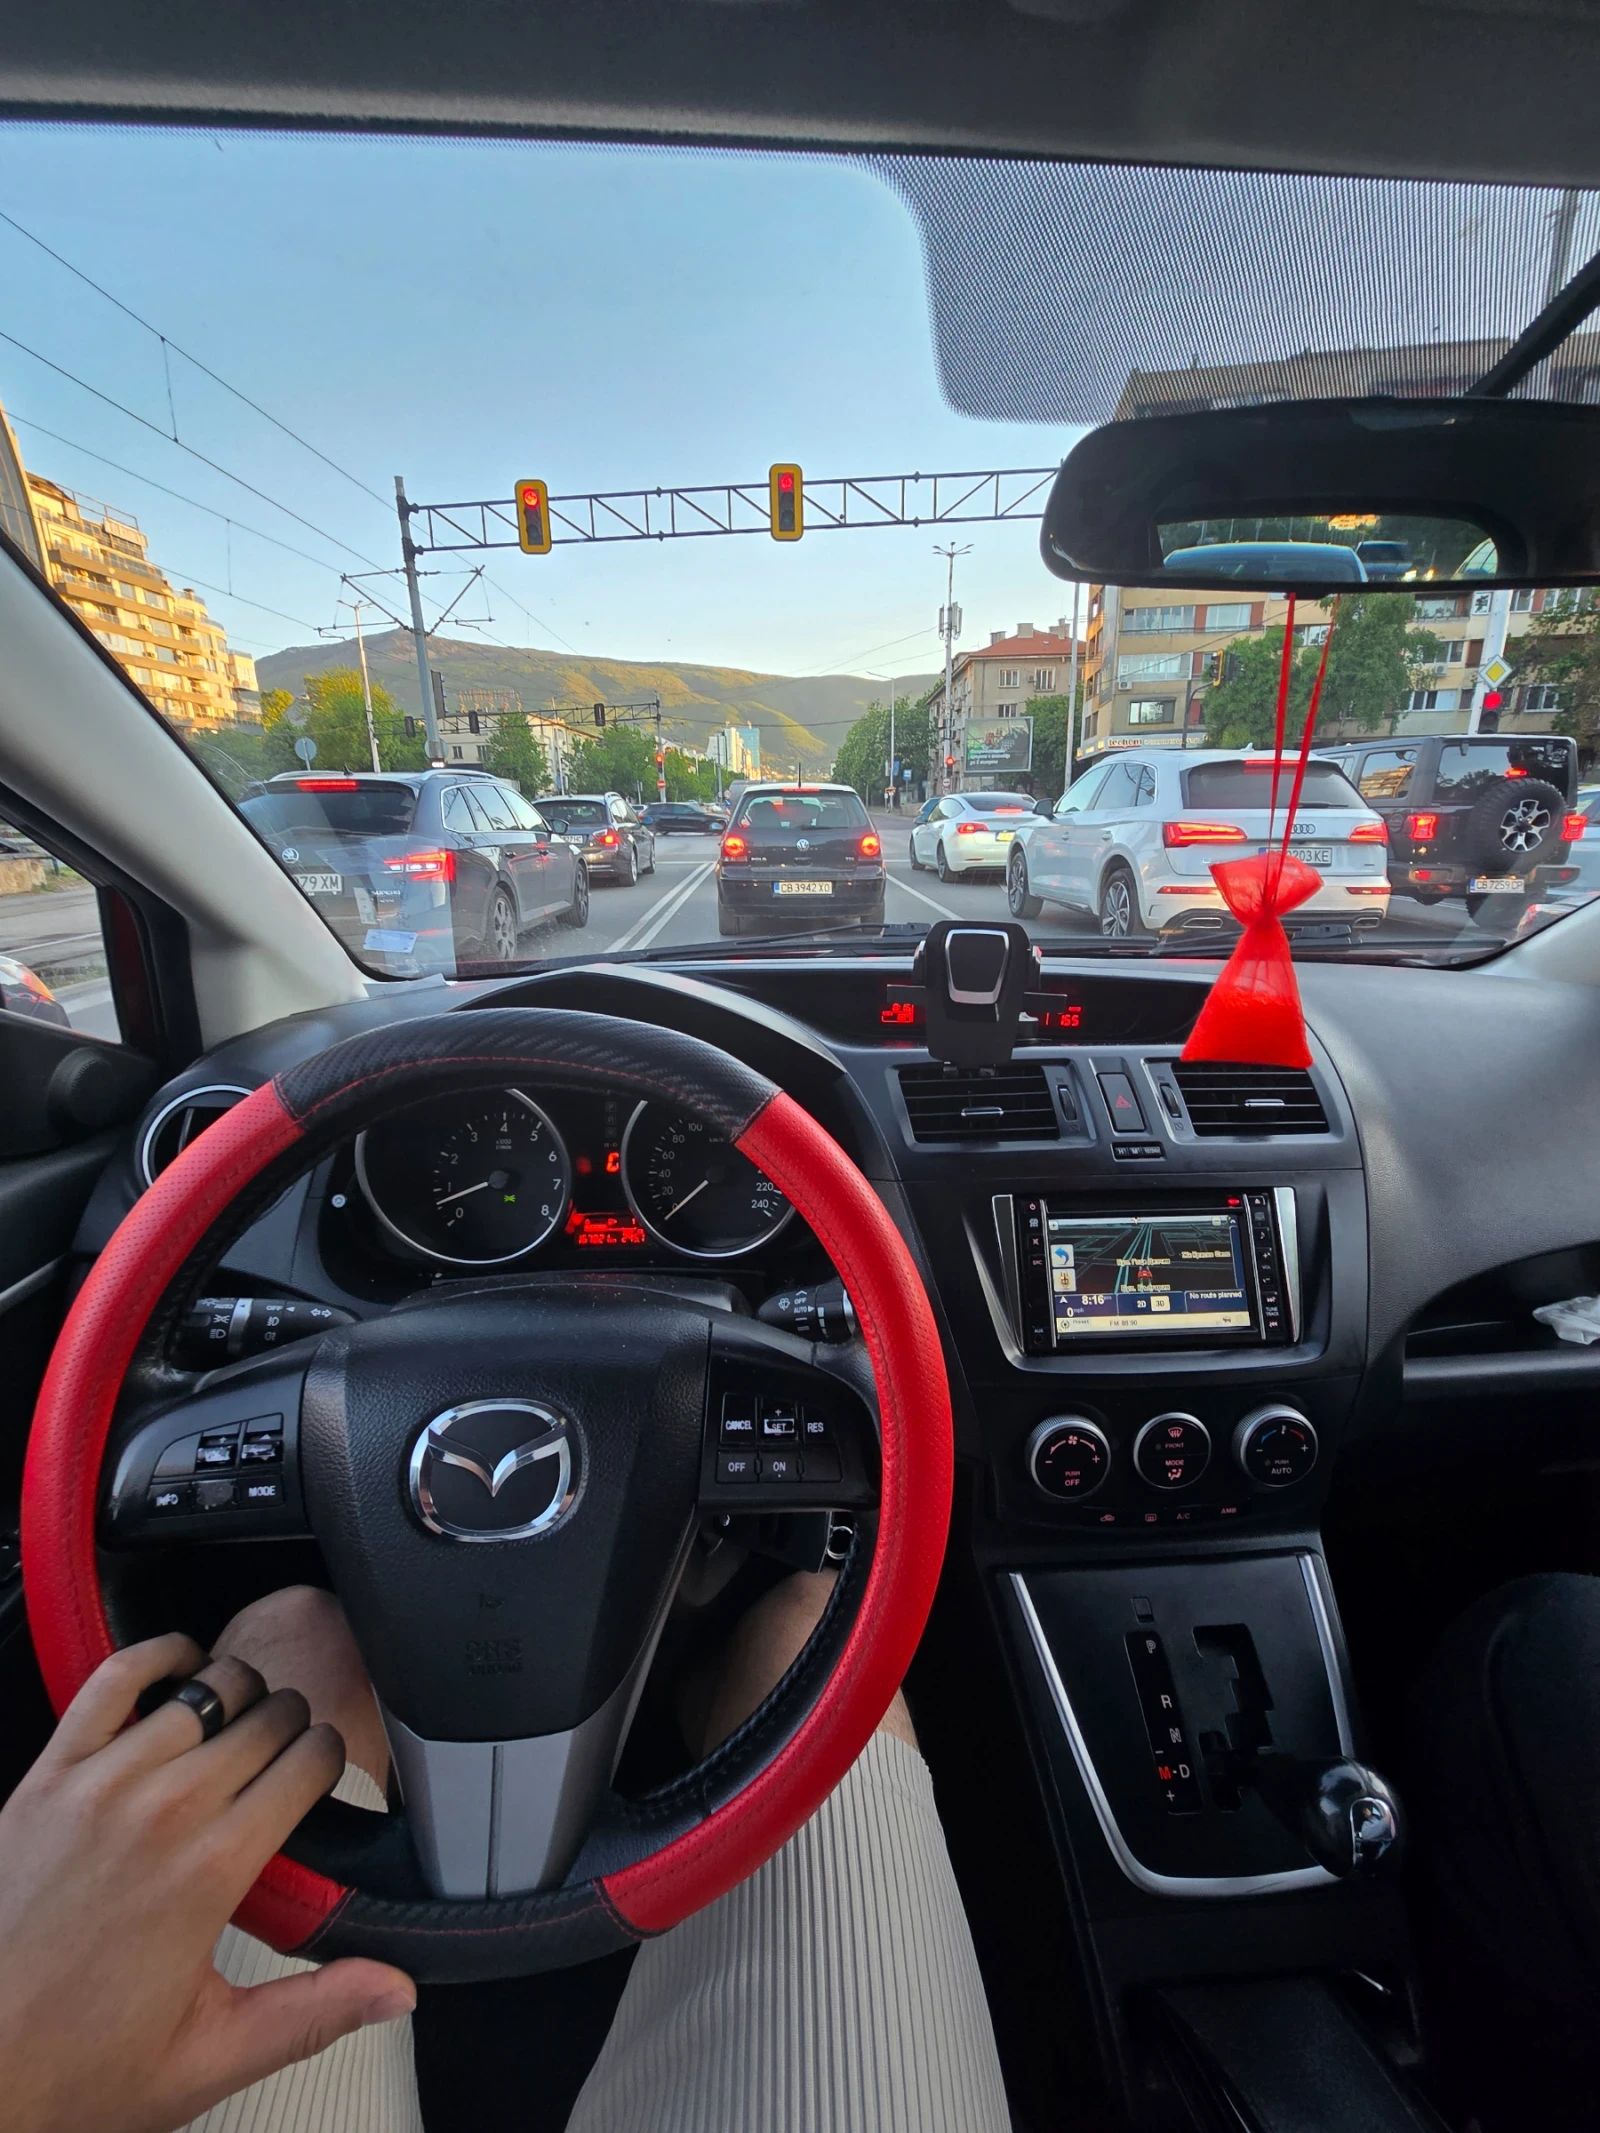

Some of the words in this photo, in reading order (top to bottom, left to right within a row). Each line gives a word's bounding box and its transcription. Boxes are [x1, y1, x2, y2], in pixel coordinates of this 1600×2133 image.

[1315, 851, 1329, 862] KE
[320, 876, 339, 890] XM
[781, 883, 793, 893] CB
[795, 883, 817, 893] 3942
[1476, 881, 1488, 890] CB
[500, 1122, 508, 1133] 4
[688, 1122, 703, 1132] 100
[470, 1131, 478, 1143] 3
[530, 1131, 538, 1142] 5
[672, 1134, 685, 1143] 80
[450, 1153, 459, 1165] 2
[548, 1151, 557, 1162] 6
[662, 1151, 675, 1160] 60
[658, 1169, 671, 1178] 40
[553, 1179, 561, 1190] 7
[756, 1182, 774, 1191] 220
[661, 1186, 674, 1195] 20
[751, 1199, 769, 1209] 240
[455, 1207, 464, 1219] 0
[541, 1204, 549, 1216] 8
[794, 1297, 807, 1305] OFF
[1081, 1294, 1105, 1306] 8:16
[1200, 1291, 1217, 1299] route
[1218, 1291, 1242, 1300] planned
[1066, 1306, 1074, 1317] 0
[807, 1422, 824, 1433] RES
[728, 1462, 746, 1473] OFF
[773, 1461, 786, 1472] ON
[1165, 1459, 1185, 1467] MODE
[1271, 1467, 1292, 1475] AUTO
[1065, 1479, 1080, 1487] OFF
[248, 1485, 276, 1498] MODE
[1146, 1639, 1157, 1654] P
[1160, 1694, 1172, 1709] R
[1169, 1727, 1182, 1743] N
